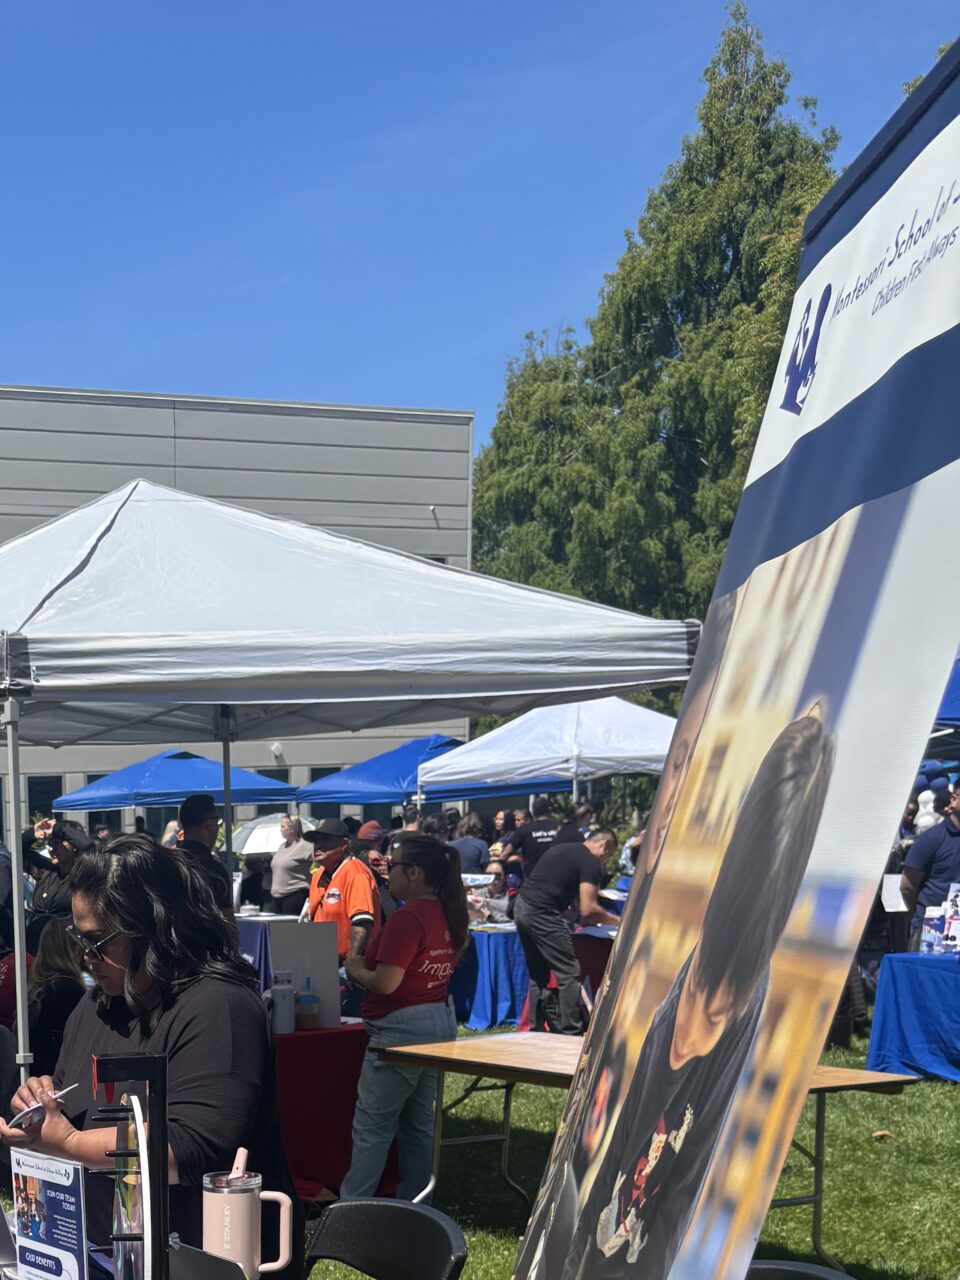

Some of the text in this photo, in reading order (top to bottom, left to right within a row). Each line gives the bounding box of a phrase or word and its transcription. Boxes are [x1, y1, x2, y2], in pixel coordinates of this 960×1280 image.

[888, 186, 944, 267] School
[936, 180, 957, 222] of
[924, 226, 959, 266] Always
[65, 1193, 76, 1203] TEAM
[36, 1255, 56, 1270] BENEFITS
